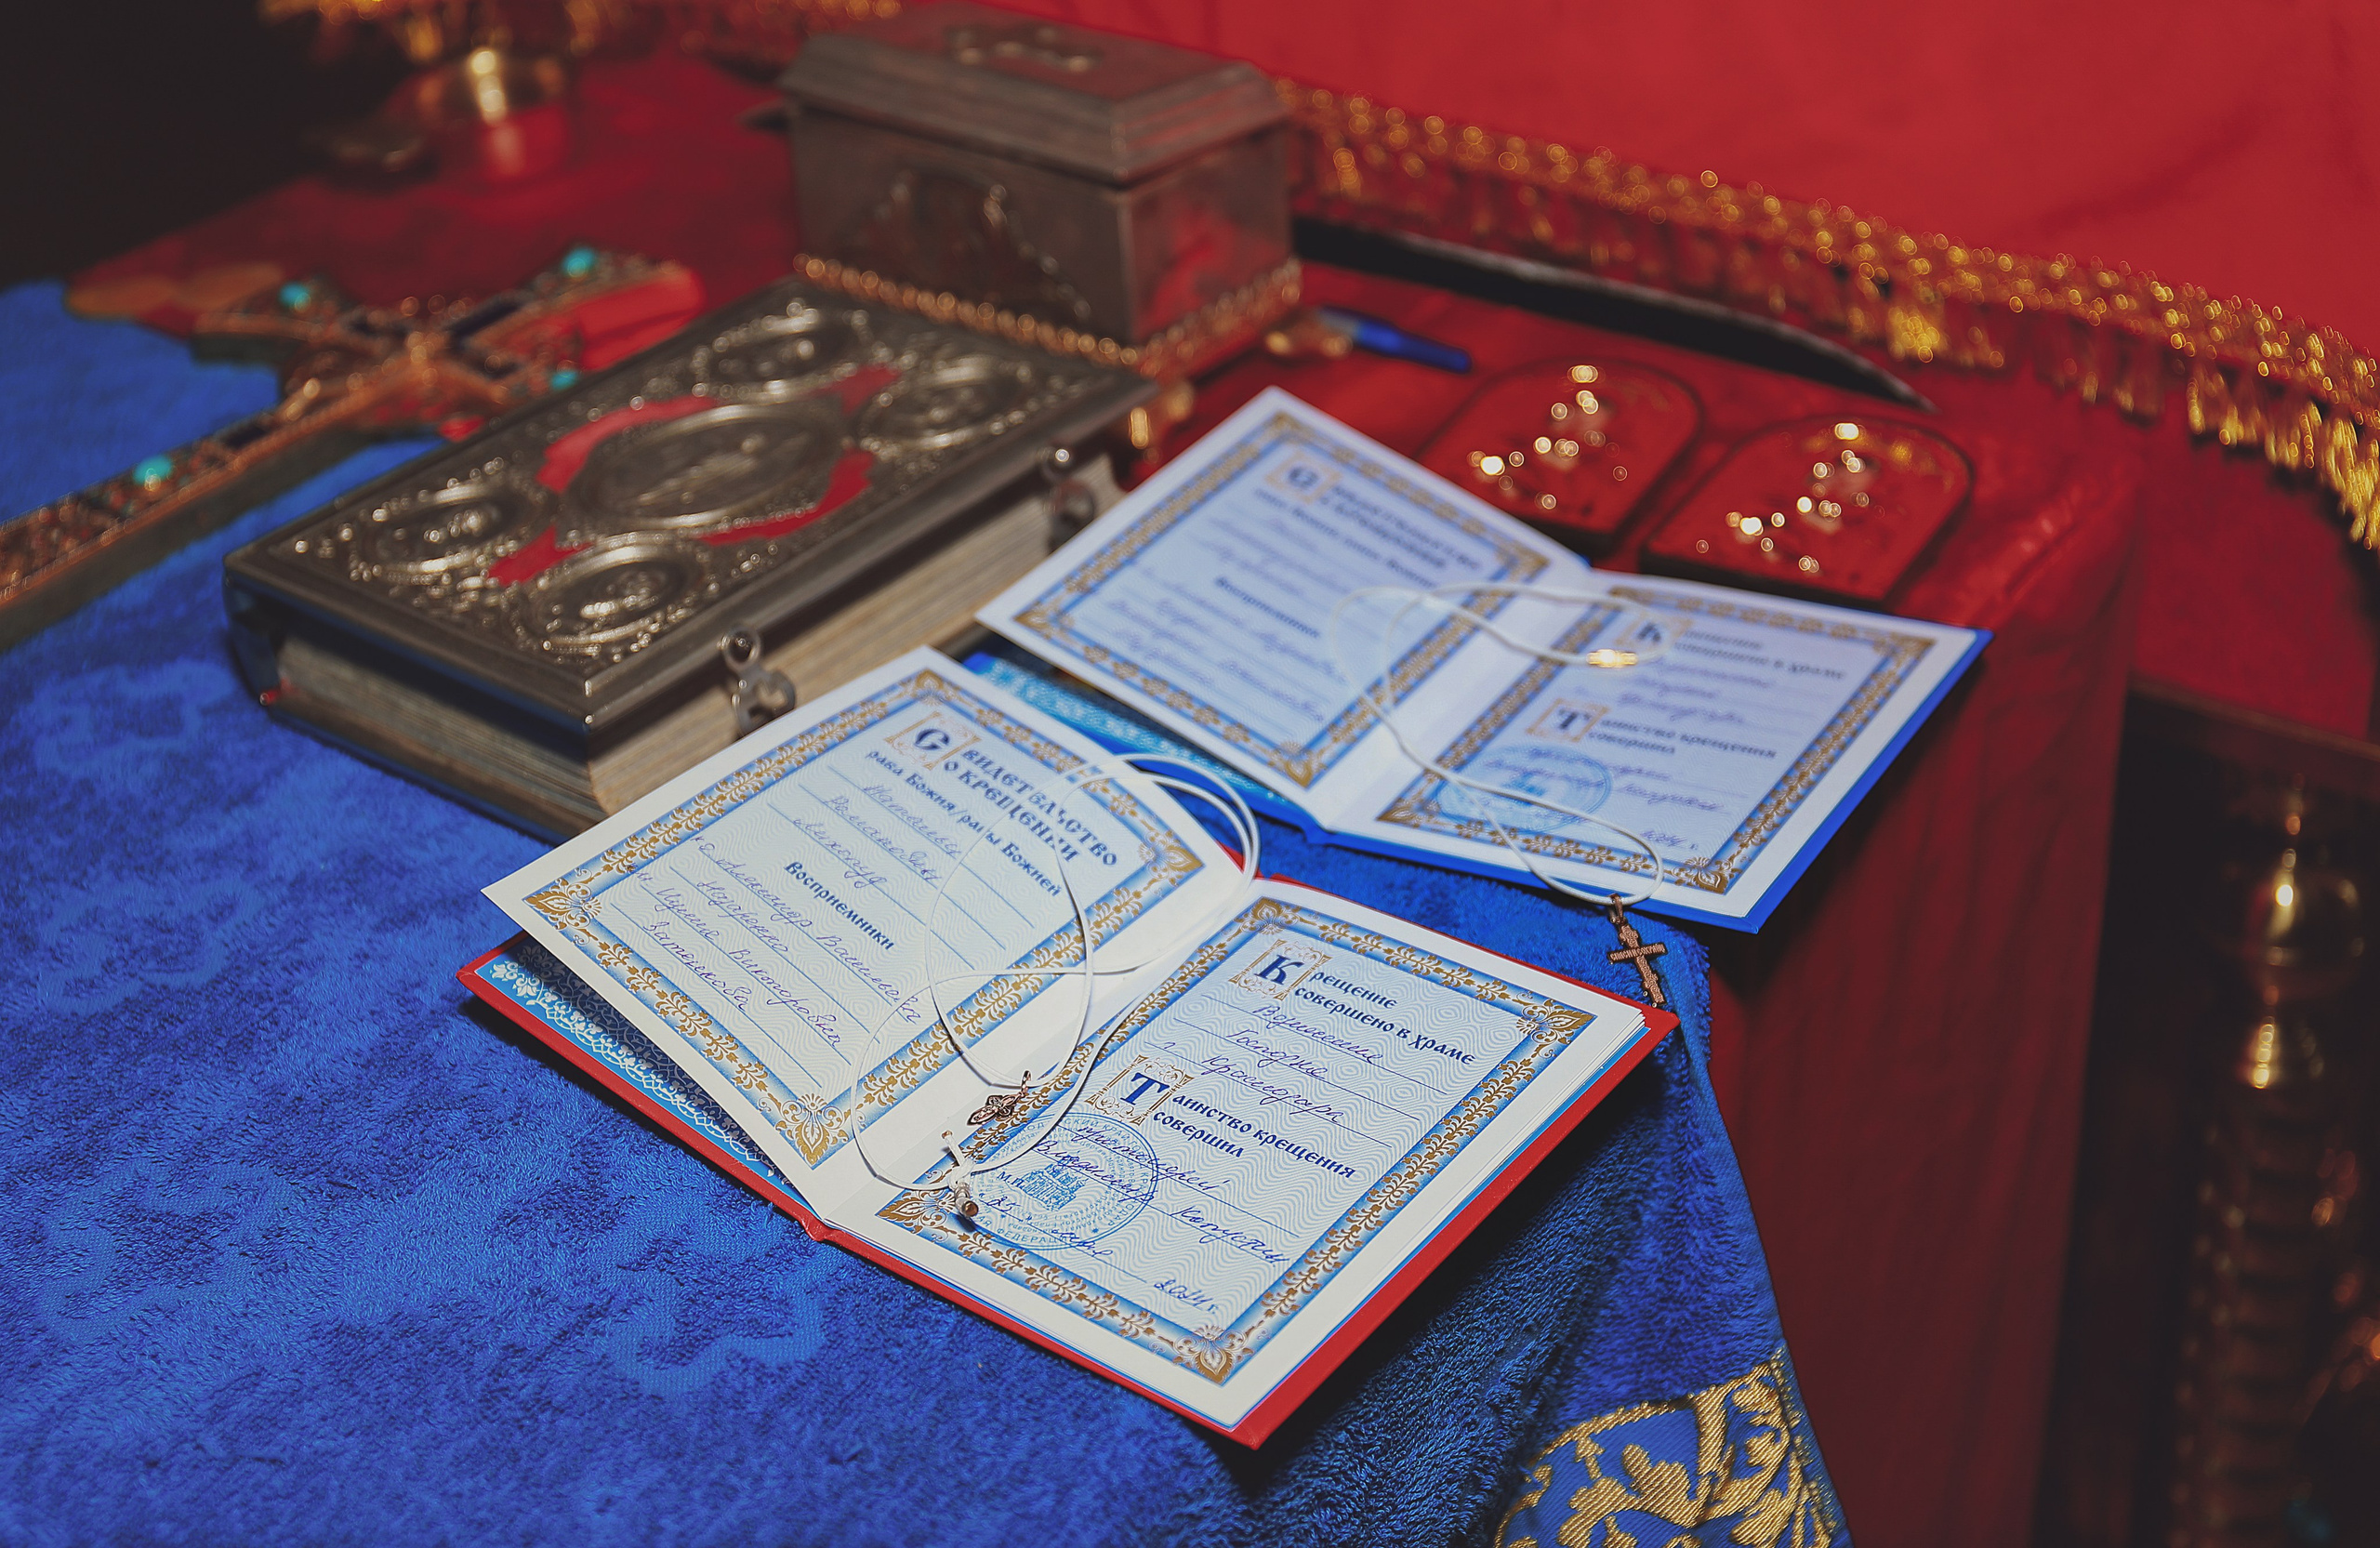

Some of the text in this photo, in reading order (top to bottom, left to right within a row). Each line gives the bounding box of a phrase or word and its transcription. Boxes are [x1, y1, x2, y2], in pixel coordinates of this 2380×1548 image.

[866, 749, 904, 776] раба
[1000, 841, 1062, 896] Божией
[784, 861, 894, 950] Восприемники
[1294, 986, 1395, 1033] совершено
[1408, 1033, 1476, 1065] храме
[1153, 1111, 1244, 1158] совершил
[1252, 1129, 1356, 1179] крещения
